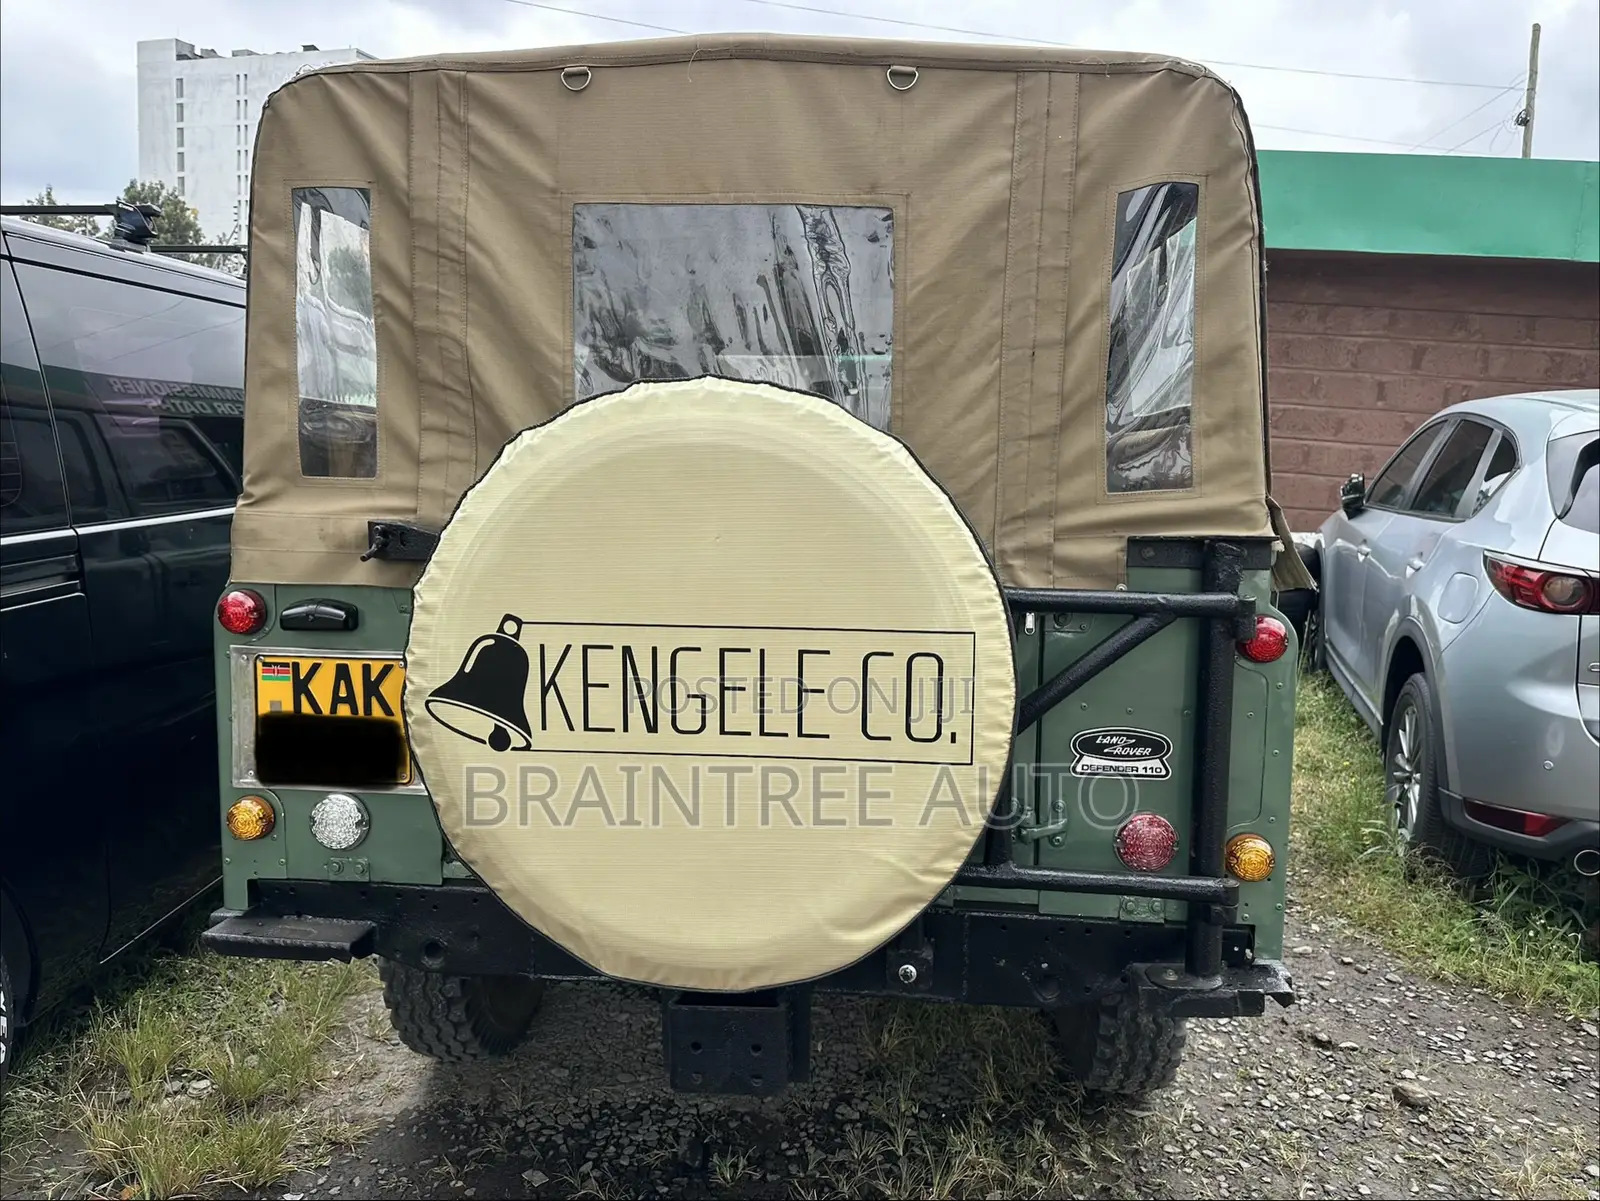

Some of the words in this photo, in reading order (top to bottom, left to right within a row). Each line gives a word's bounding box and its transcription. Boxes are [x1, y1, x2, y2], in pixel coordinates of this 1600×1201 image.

[291, 660, 395, 716] KAK
[539, 643, 830, 740] KENGELE
[861, 651, 957, 744] CO.
[1095, 735, 1128, 745] LAND
[1112, 747, 1152, 756] ROVER
[1081, 764, 1139, 773] DEFENDER
[1142, 765, 1163, 774] 110
